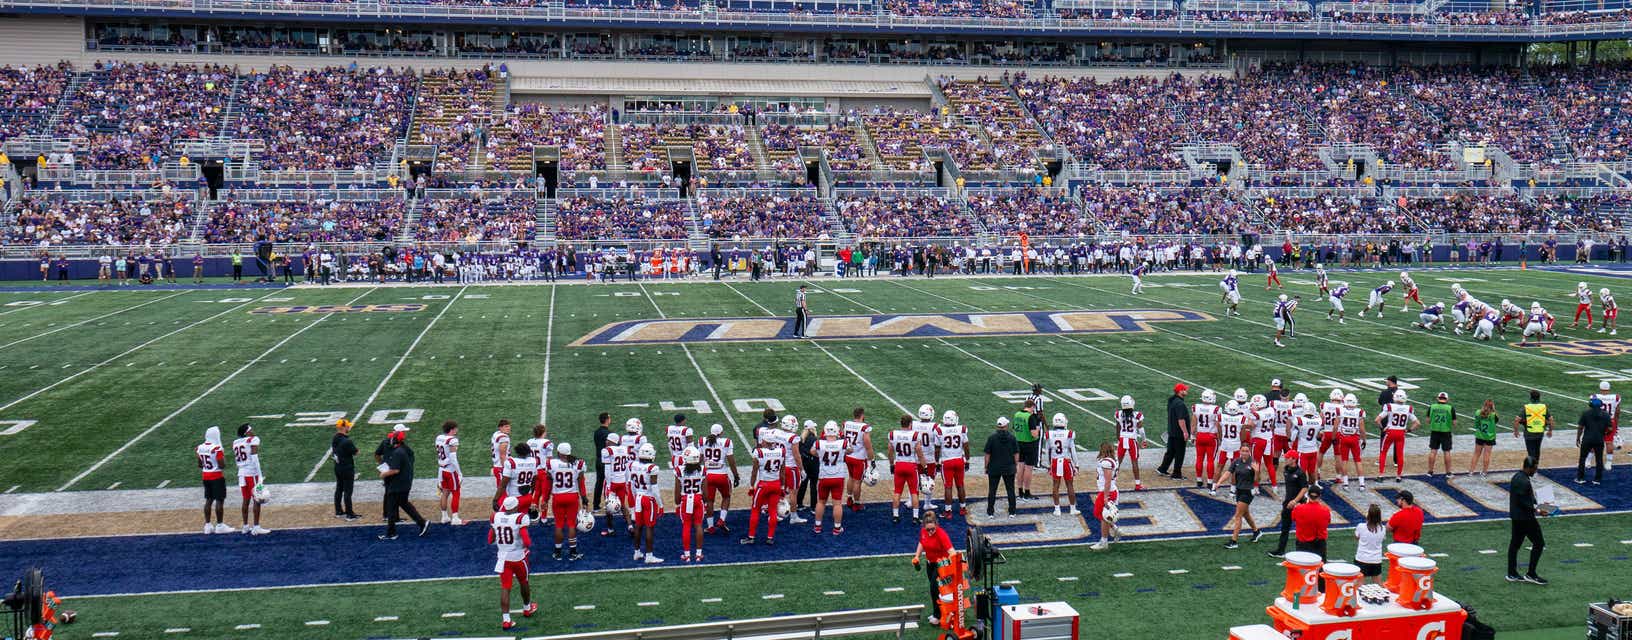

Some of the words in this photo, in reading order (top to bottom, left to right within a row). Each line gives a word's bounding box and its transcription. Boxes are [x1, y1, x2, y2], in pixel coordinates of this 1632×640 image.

[991, 387, 1120, 404] 50
[285, 408, 424, 428] 30
[1198, 414, 1210, 429] 41
[1342, 416, 1358, 429] 48
[1392, 413, 1408, 427] 38
[1121, 419, 1135, 433] 12
[1224, 424, 1237, 439] 19
[1306, 427, 1316, 441] 9
[668, 436, 683, 451] 39
[895, 441, 912, 457] 40
[944, 435, 961, 449] 33
[1054, 439, 1063, 455] 3
[704, 448, 721, 463] 99
[822, 450, 840, 466] 47
[613, 455, 627, 473] 20
[763, 458, 782, 473] 43
[555, 471, 573, 488] 93
[631, 473, 648, 491] 34
[684, 478, 700, 494] 25
[496, 525, 514, 545] 10
[1304, 570, 1317, 586] G
[1419, 575, 1432, 590] G
[1340, 582, 1355, 597] G
